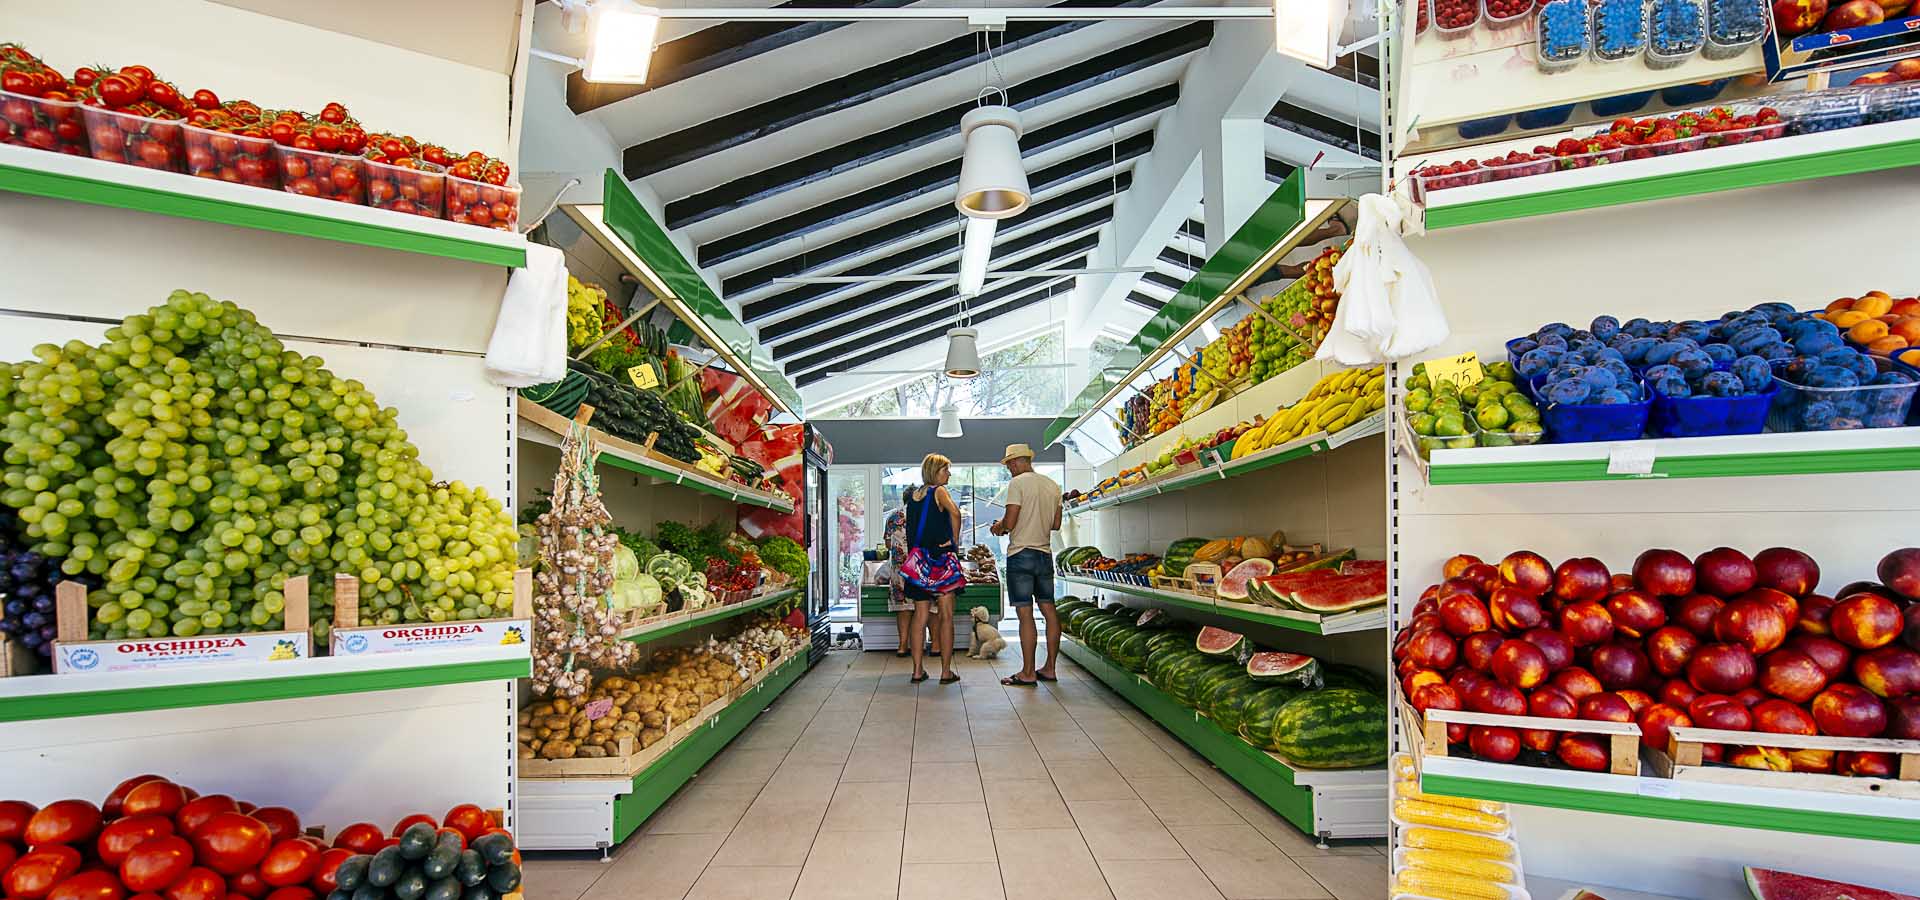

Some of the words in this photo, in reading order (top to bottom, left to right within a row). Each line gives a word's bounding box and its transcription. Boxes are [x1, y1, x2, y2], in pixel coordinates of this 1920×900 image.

[382, 624, 484, 639] ORCHIDEA
[117, 637, 247, 653] ORCHIDEA
[148, 648, 219, 657] FRUTTA
